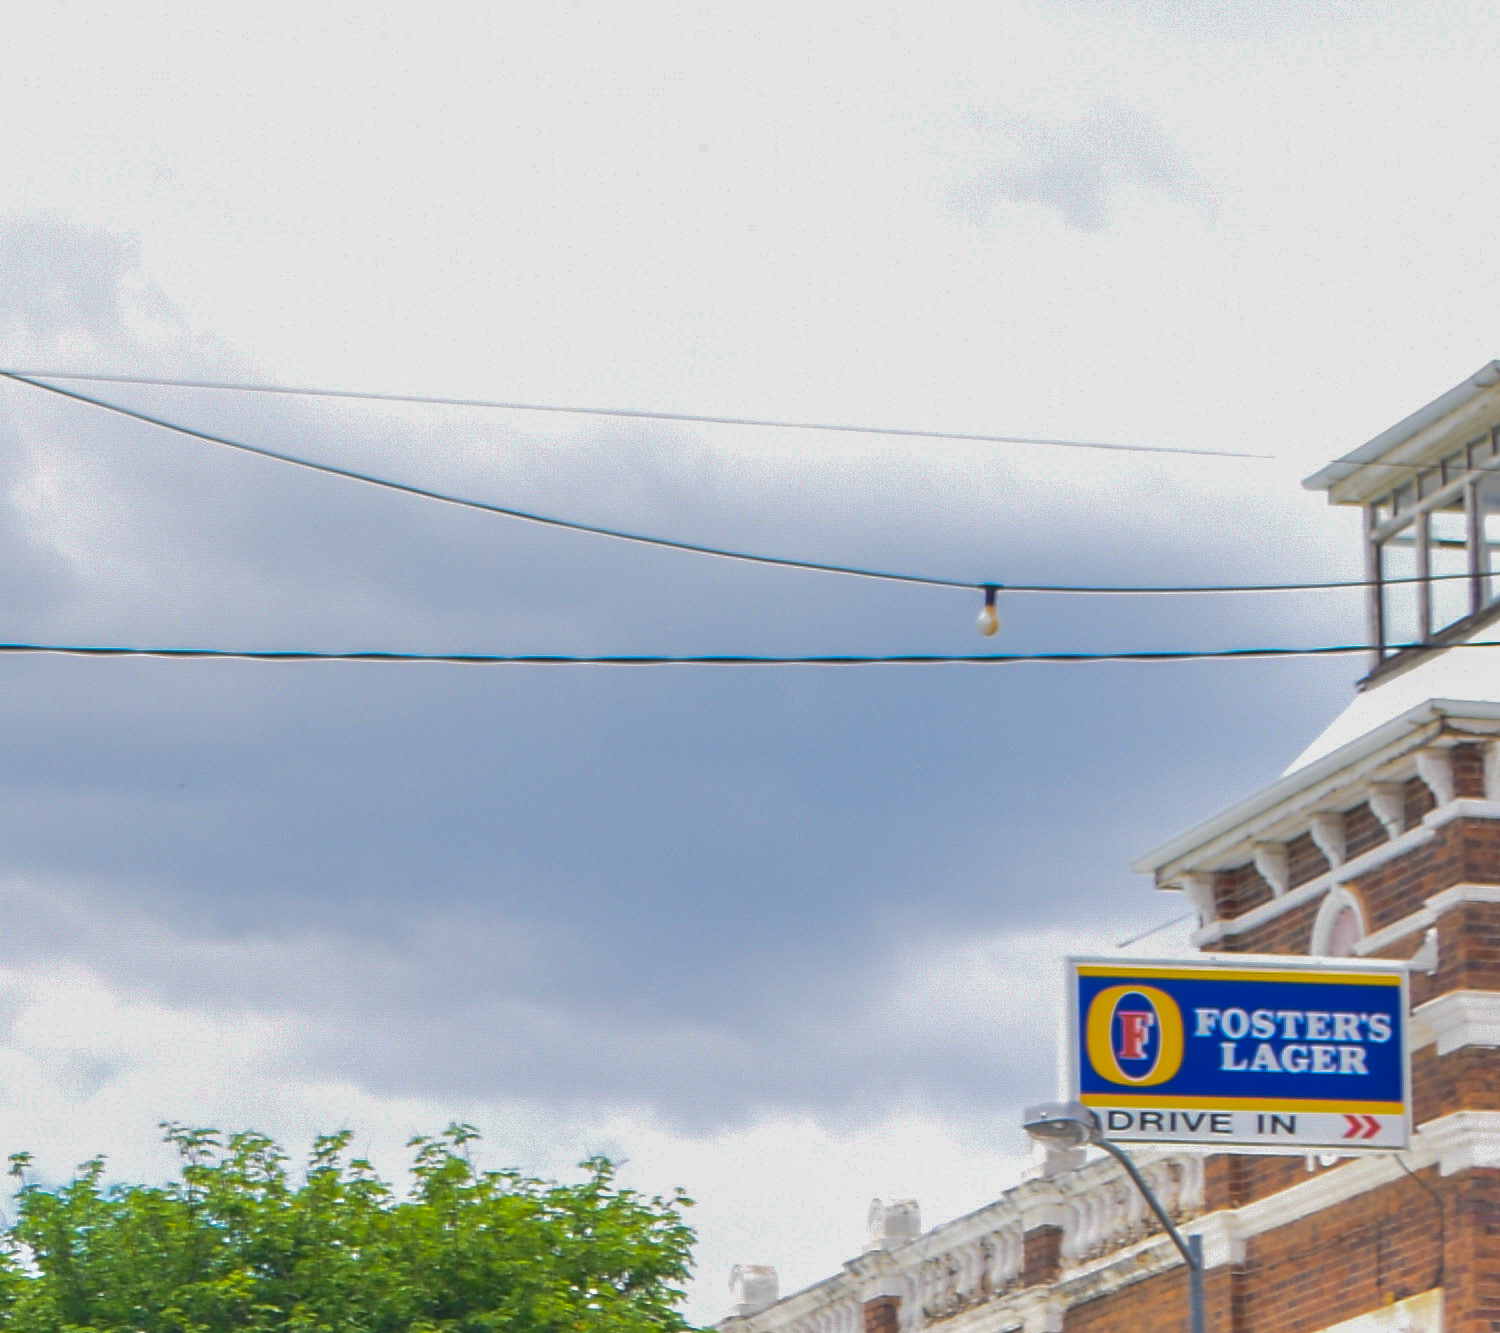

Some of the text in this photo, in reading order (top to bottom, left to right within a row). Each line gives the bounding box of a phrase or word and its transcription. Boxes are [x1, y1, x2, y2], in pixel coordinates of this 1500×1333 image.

[1193, 1006, 1393, 1043] FOSTER'S
[1219, 1042, 1369, 1075] LAGER
[1108, 1110, 1296, 1136] DRIVE IN
